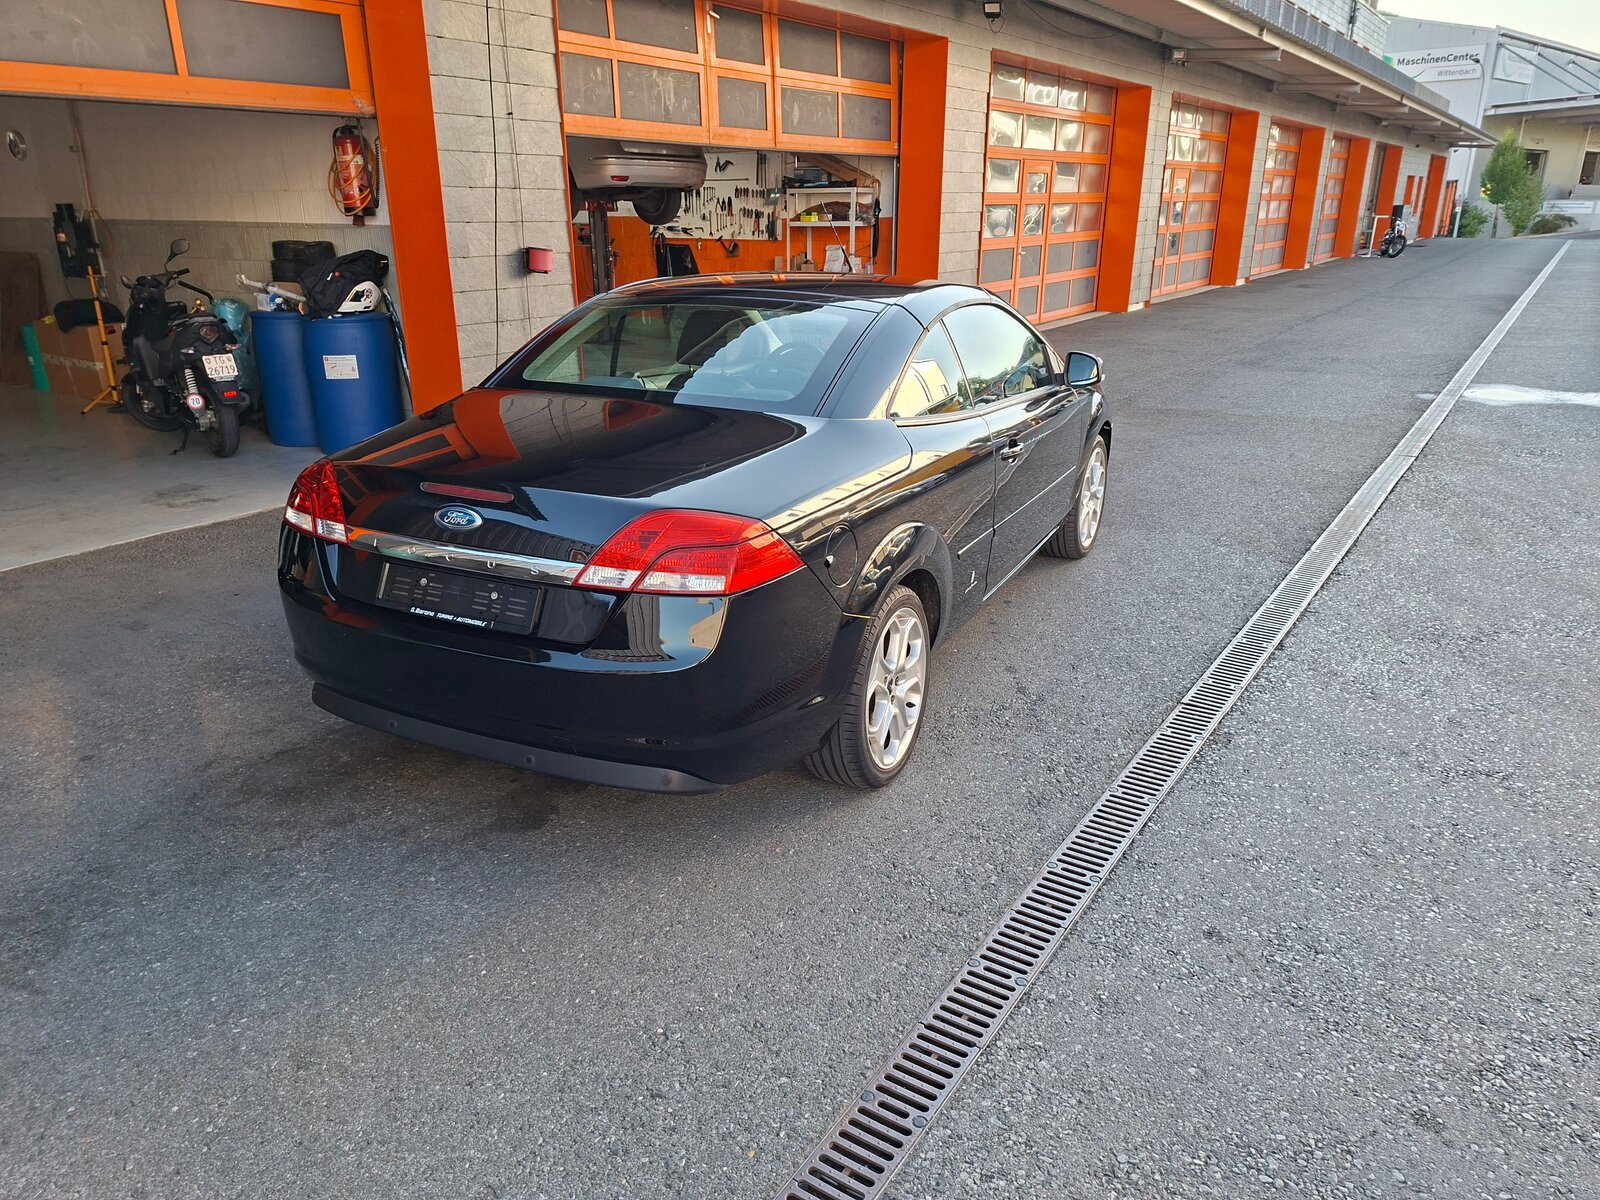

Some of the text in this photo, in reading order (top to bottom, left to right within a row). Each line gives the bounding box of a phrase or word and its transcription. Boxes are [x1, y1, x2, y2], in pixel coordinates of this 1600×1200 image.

[1437, 68, 1477, 77] Wittenbach
[213, 356, 225, 364] TG
[208, 364, 236, 376] 26719
[190, 397, 201, 405] 70
[444, 510, 469, 525] Ford
